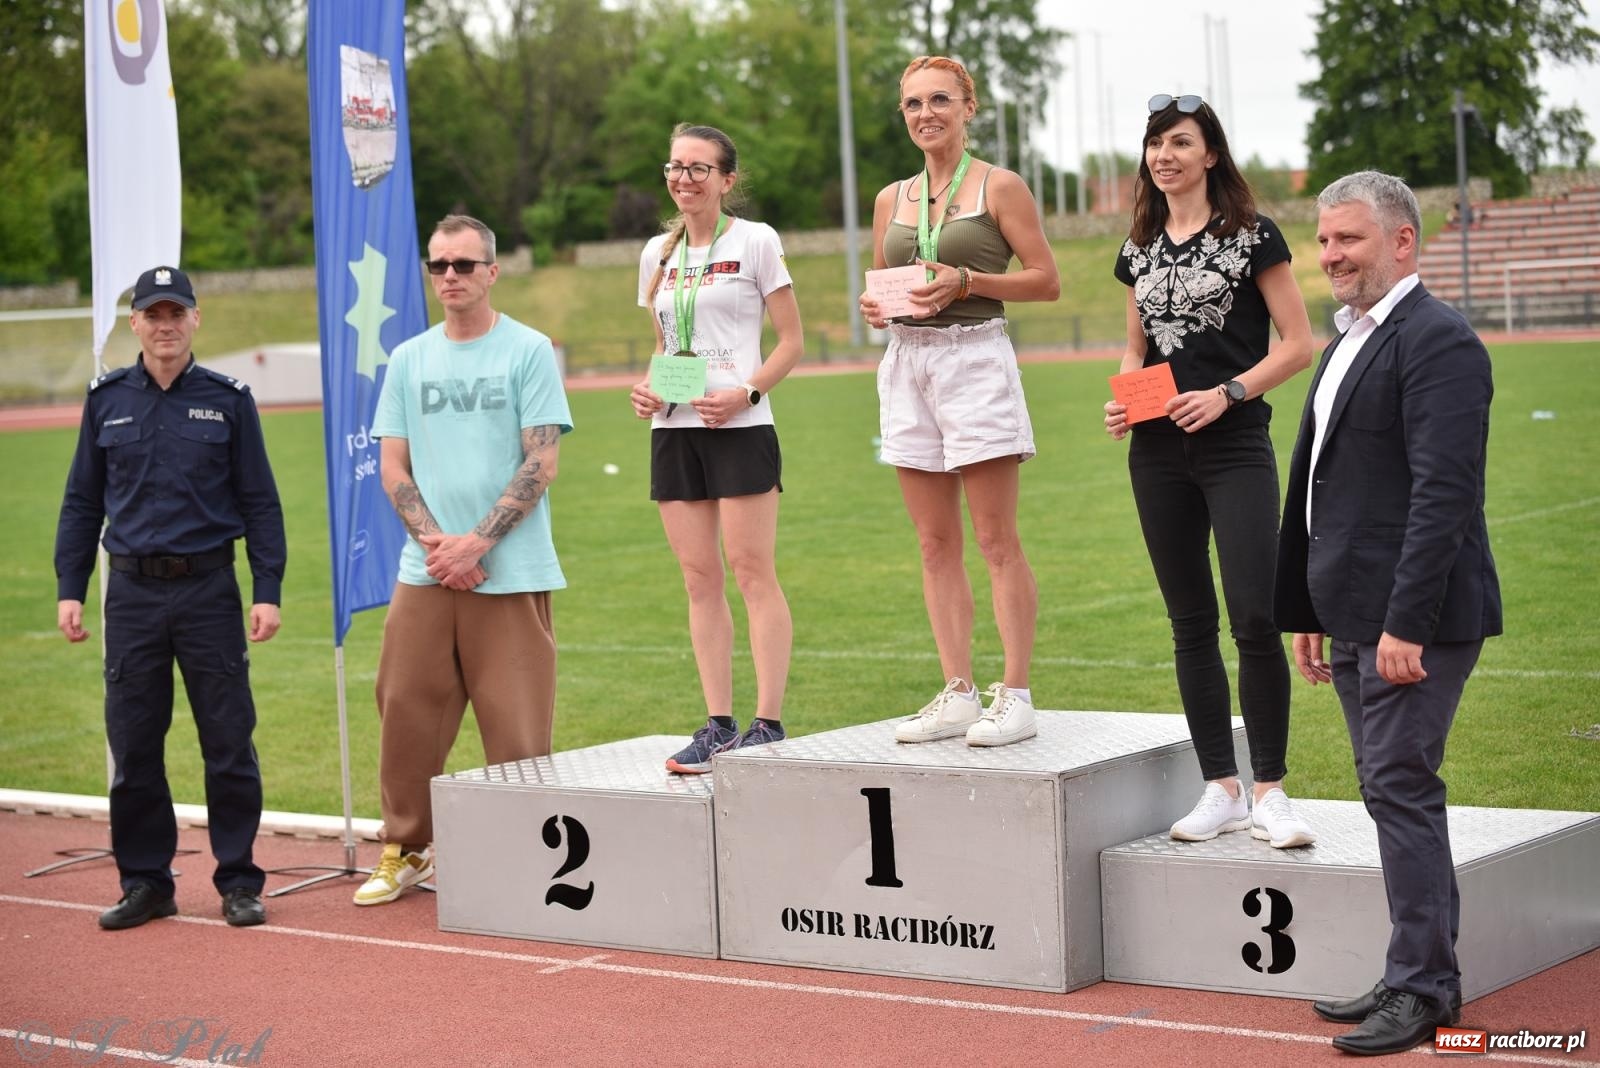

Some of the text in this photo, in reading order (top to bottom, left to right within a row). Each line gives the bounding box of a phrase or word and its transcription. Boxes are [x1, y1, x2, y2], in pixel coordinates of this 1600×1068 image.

[712, 261, 738, 274] BEZ
[697, 348, 735, 358] 800 LAT
[188, 408, 225, 423] POLICJA
[860, 787, 904, 888] 1
[541, 814, 595, 911] 2
[781, 907, 996, 951] OSIR RACIBÓRZ
[1241, 886, 1297, 975] 3
